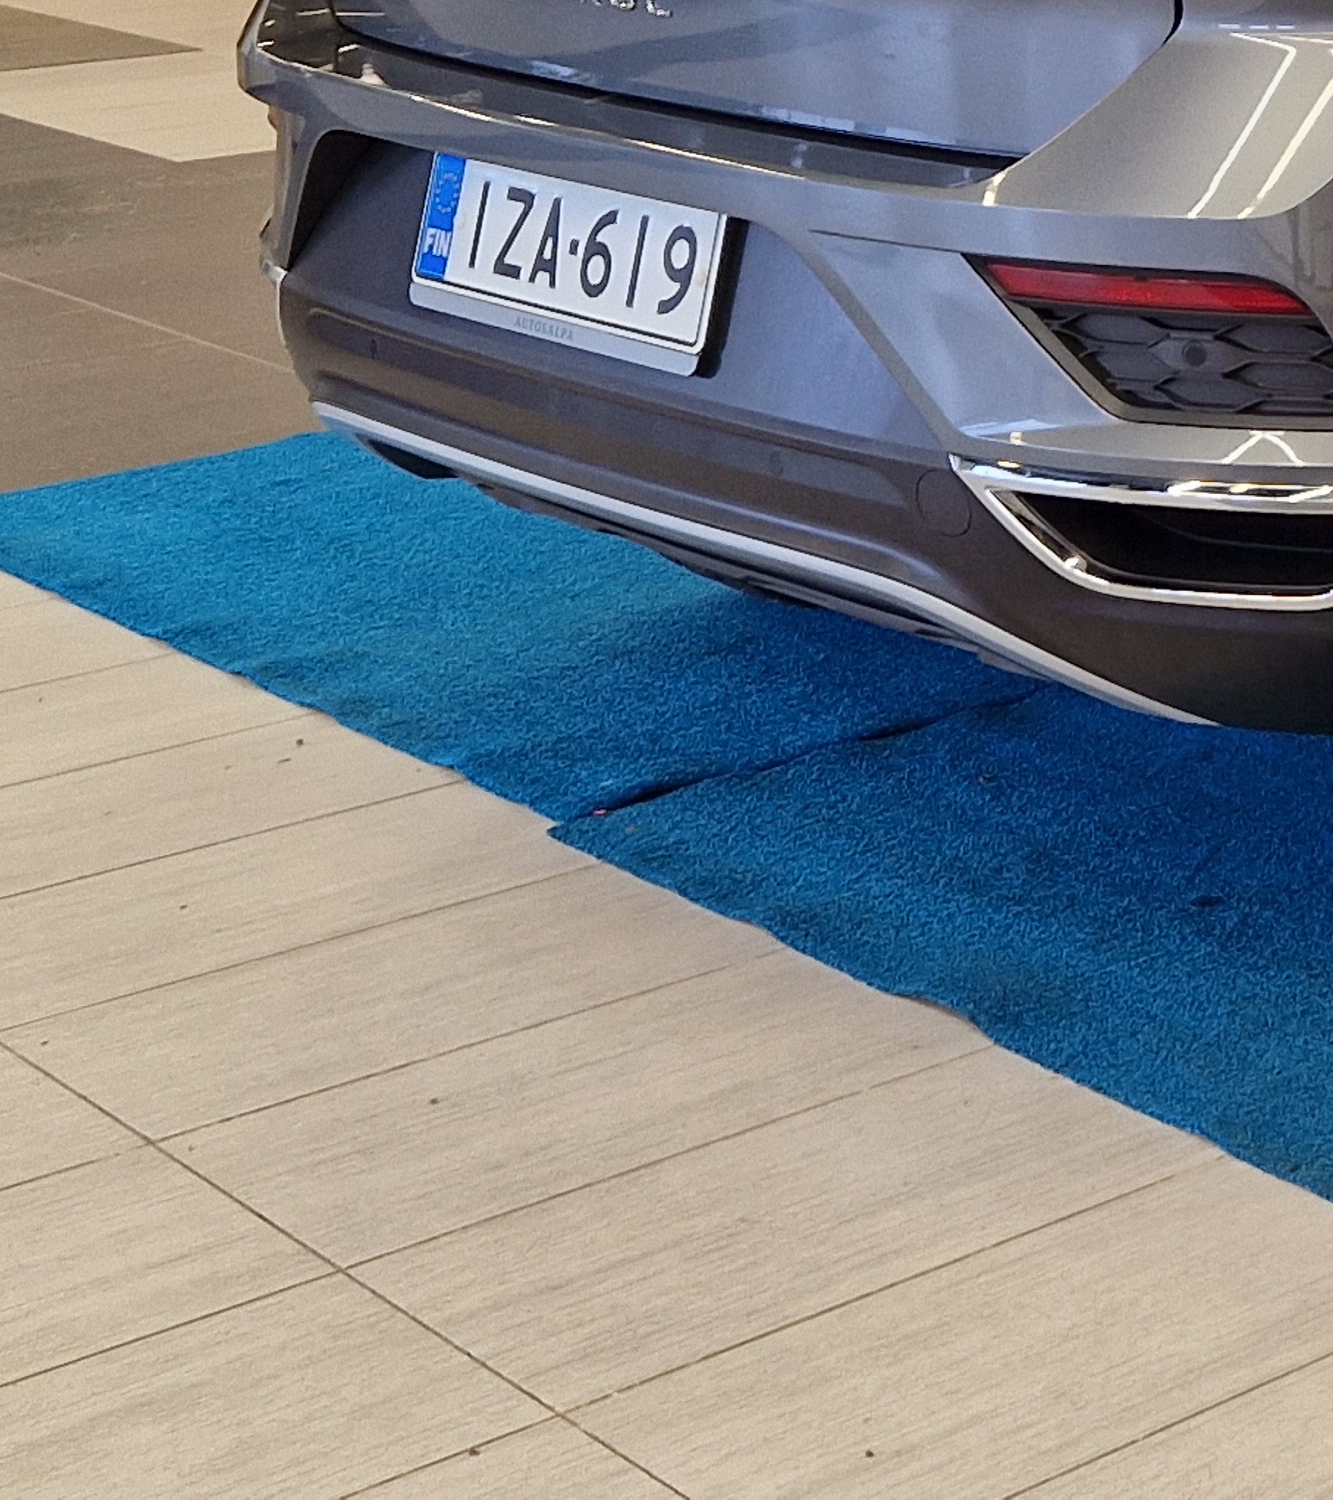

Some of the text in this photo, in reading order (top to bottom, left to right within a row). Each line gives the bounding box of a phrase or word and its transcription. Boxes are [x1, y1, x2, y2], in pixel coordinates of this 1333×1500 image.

[425, 227, 452, 257] FIN
[468, 181, 698, 315] IZA-619
[514, 315, 573, 342] AUTOSALPA
